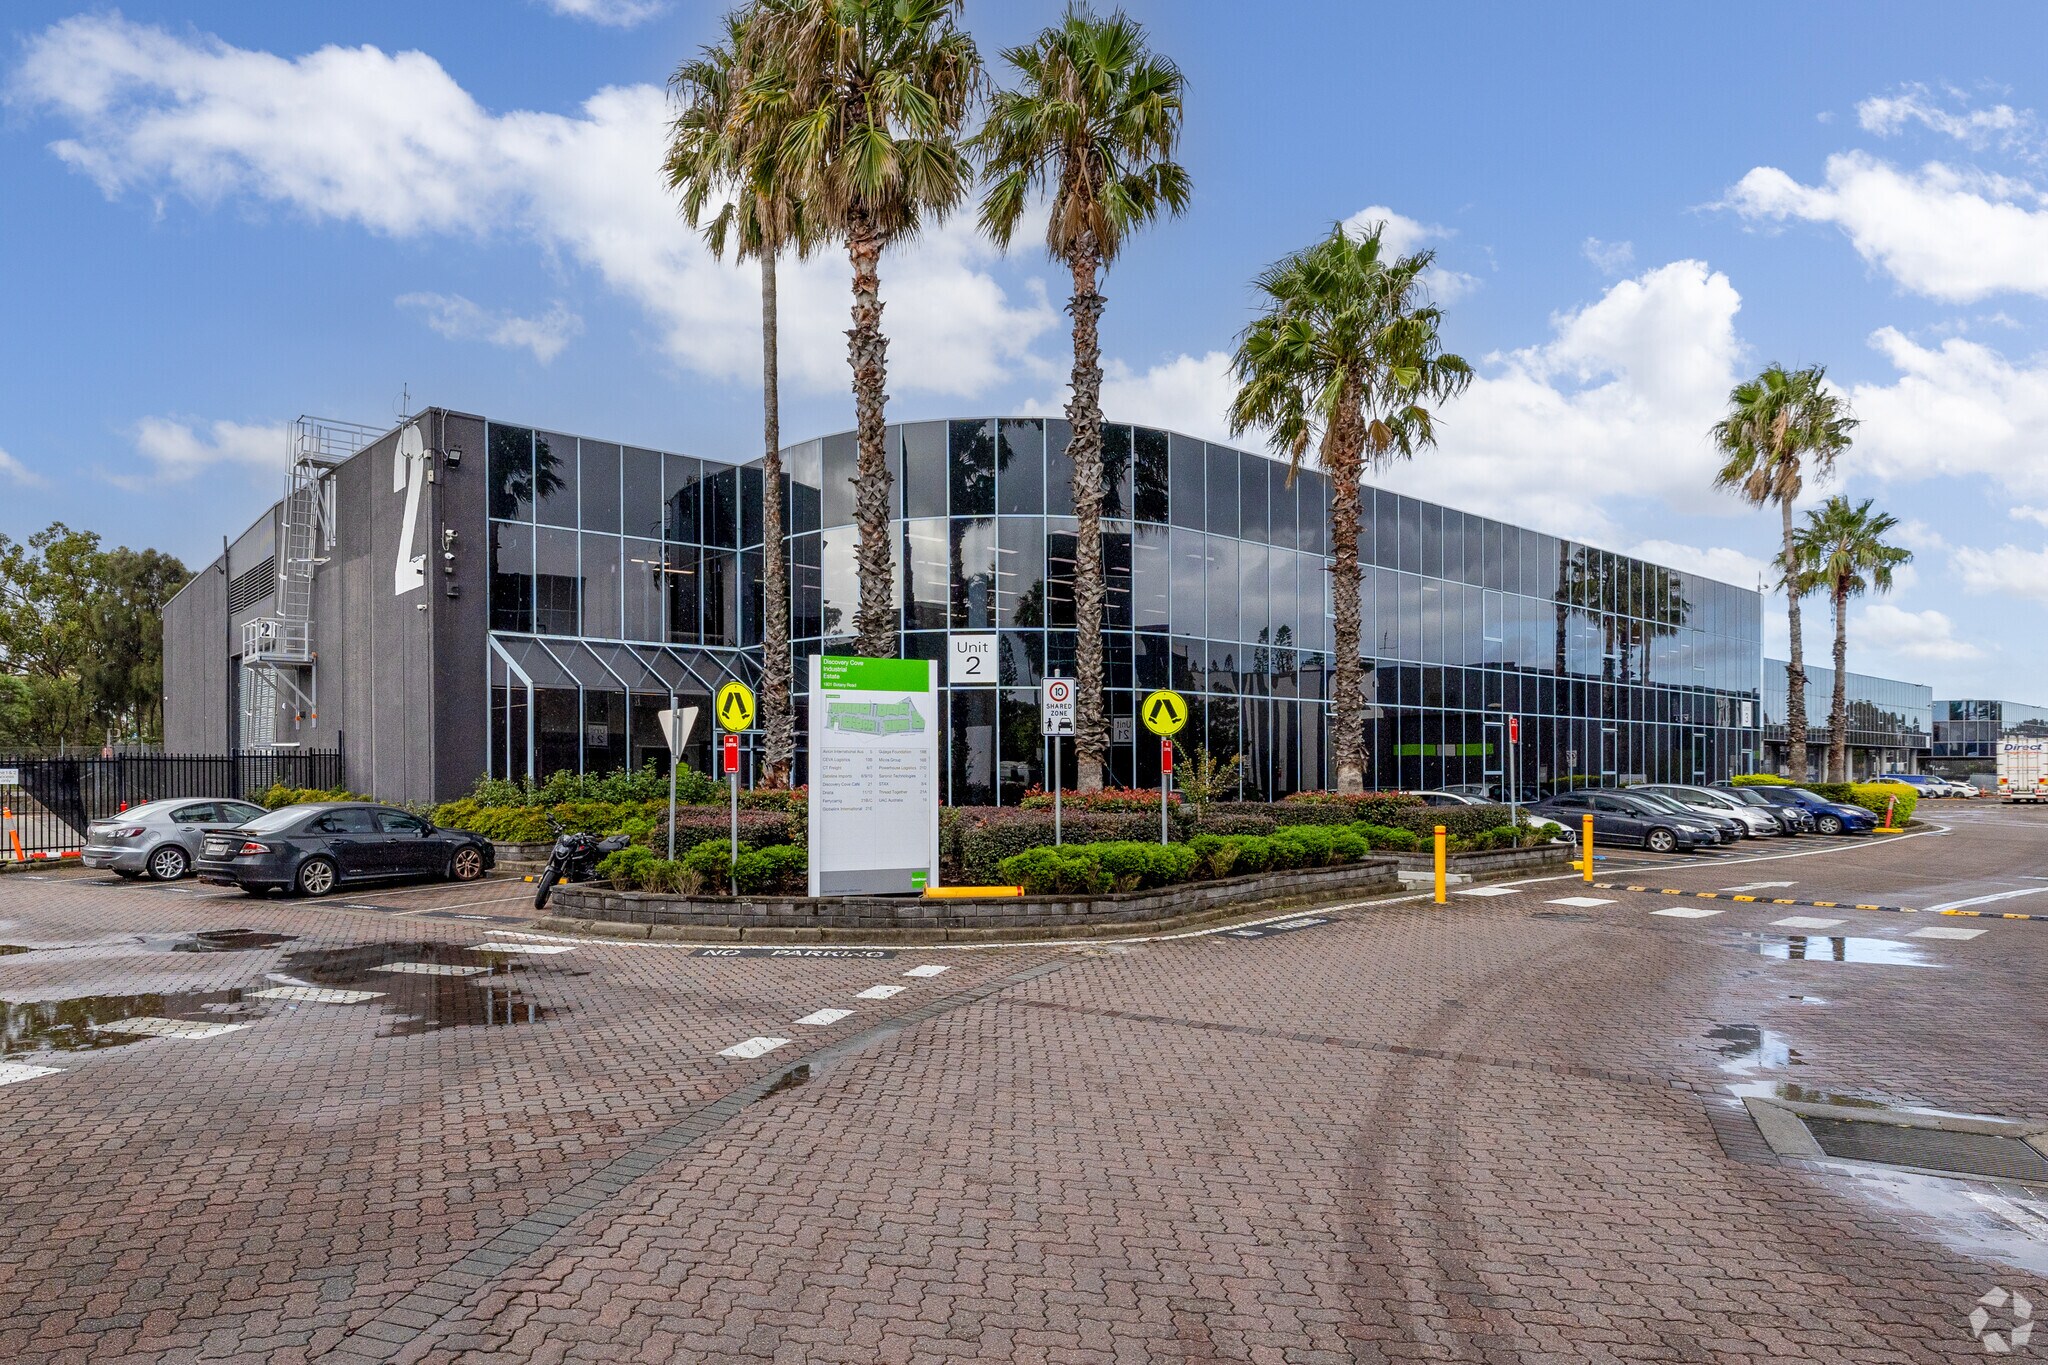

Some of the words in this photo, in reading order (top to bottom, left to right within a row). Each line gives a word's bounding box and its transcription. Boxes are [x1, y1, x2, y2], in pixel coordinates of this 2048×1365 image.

[394, 424, 424, 596] 2
[261, 623, 270, 637] 2
[957, 641, 988, 653] Unit
[823, 658, 849, 666] Discovery
[966, 656, 981, 675] 2
[1055, 688, 1064, 696] 10
[2004, 743, 2043, 751] Direct
